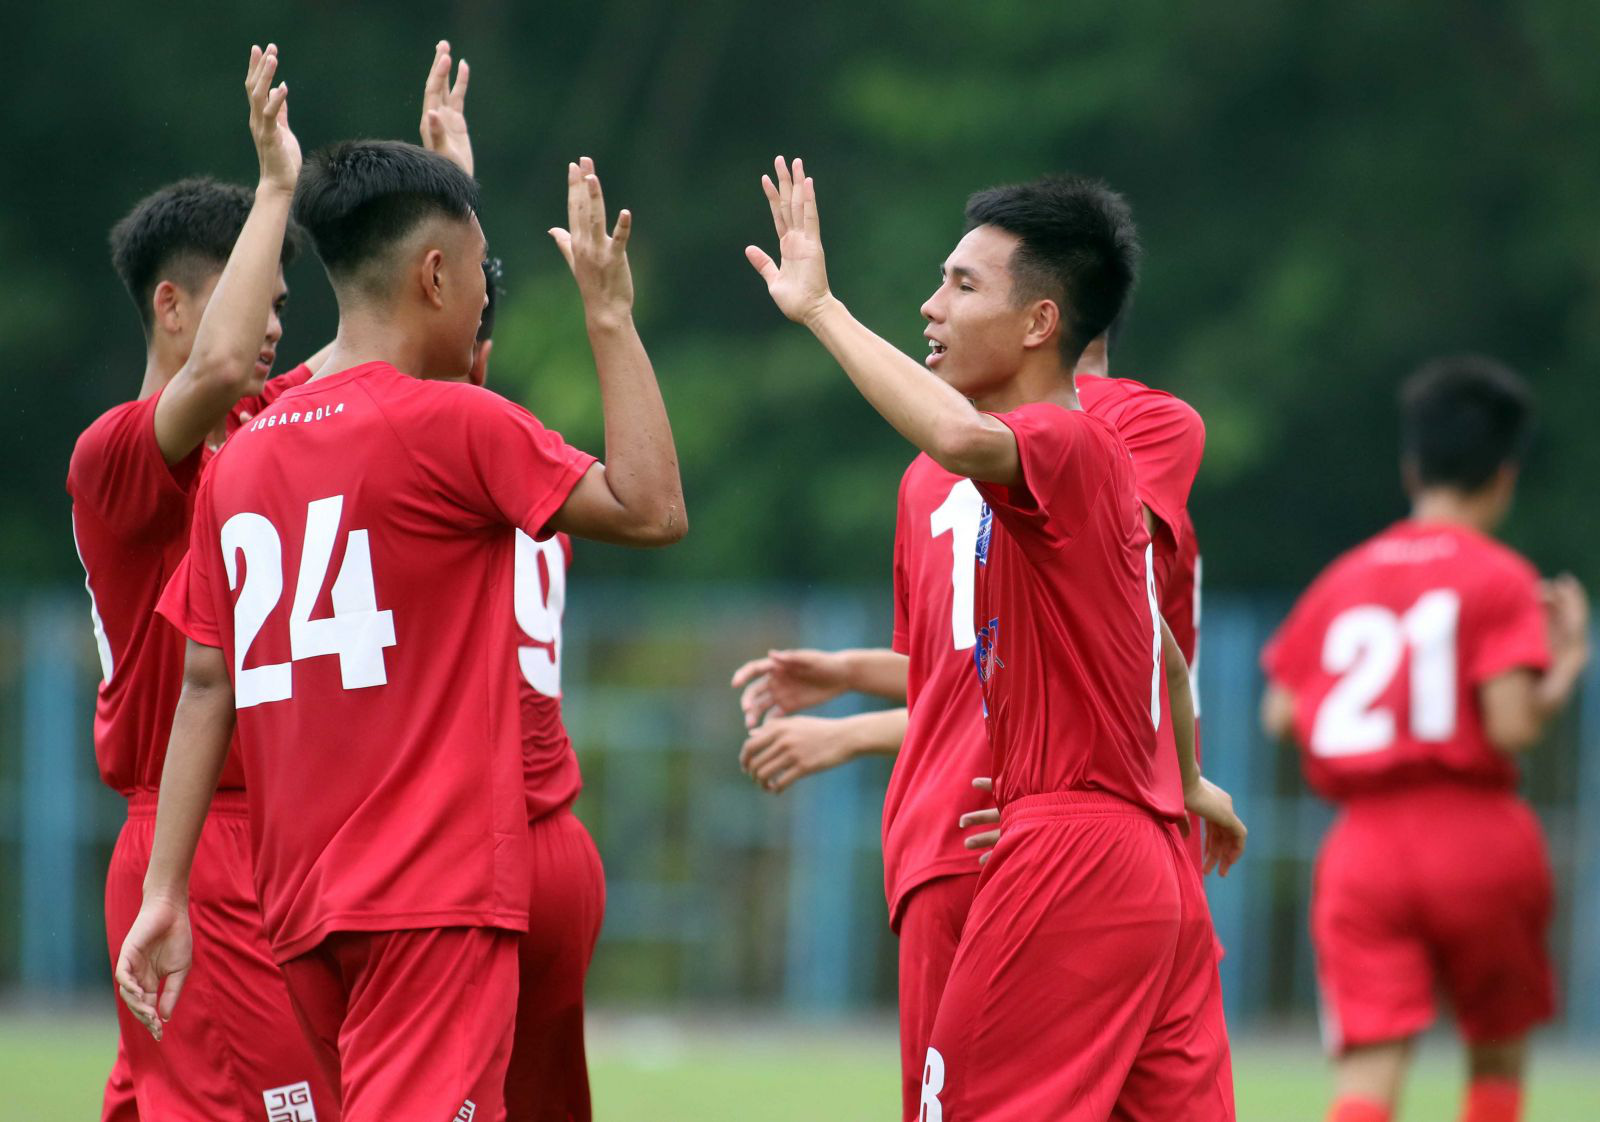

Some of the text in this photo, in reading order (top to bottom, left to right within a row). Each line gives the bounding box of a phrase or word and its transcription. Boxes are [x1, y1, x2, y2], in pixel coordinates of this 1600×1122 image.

[250, 403, 344, 432] JOGARBOLA
[220, 495, 396, 709] 24
[514, 527, 566, 698] 9
[1310, 588, 1460, 757] 21
[270, 1087, 308, 1111] JG
